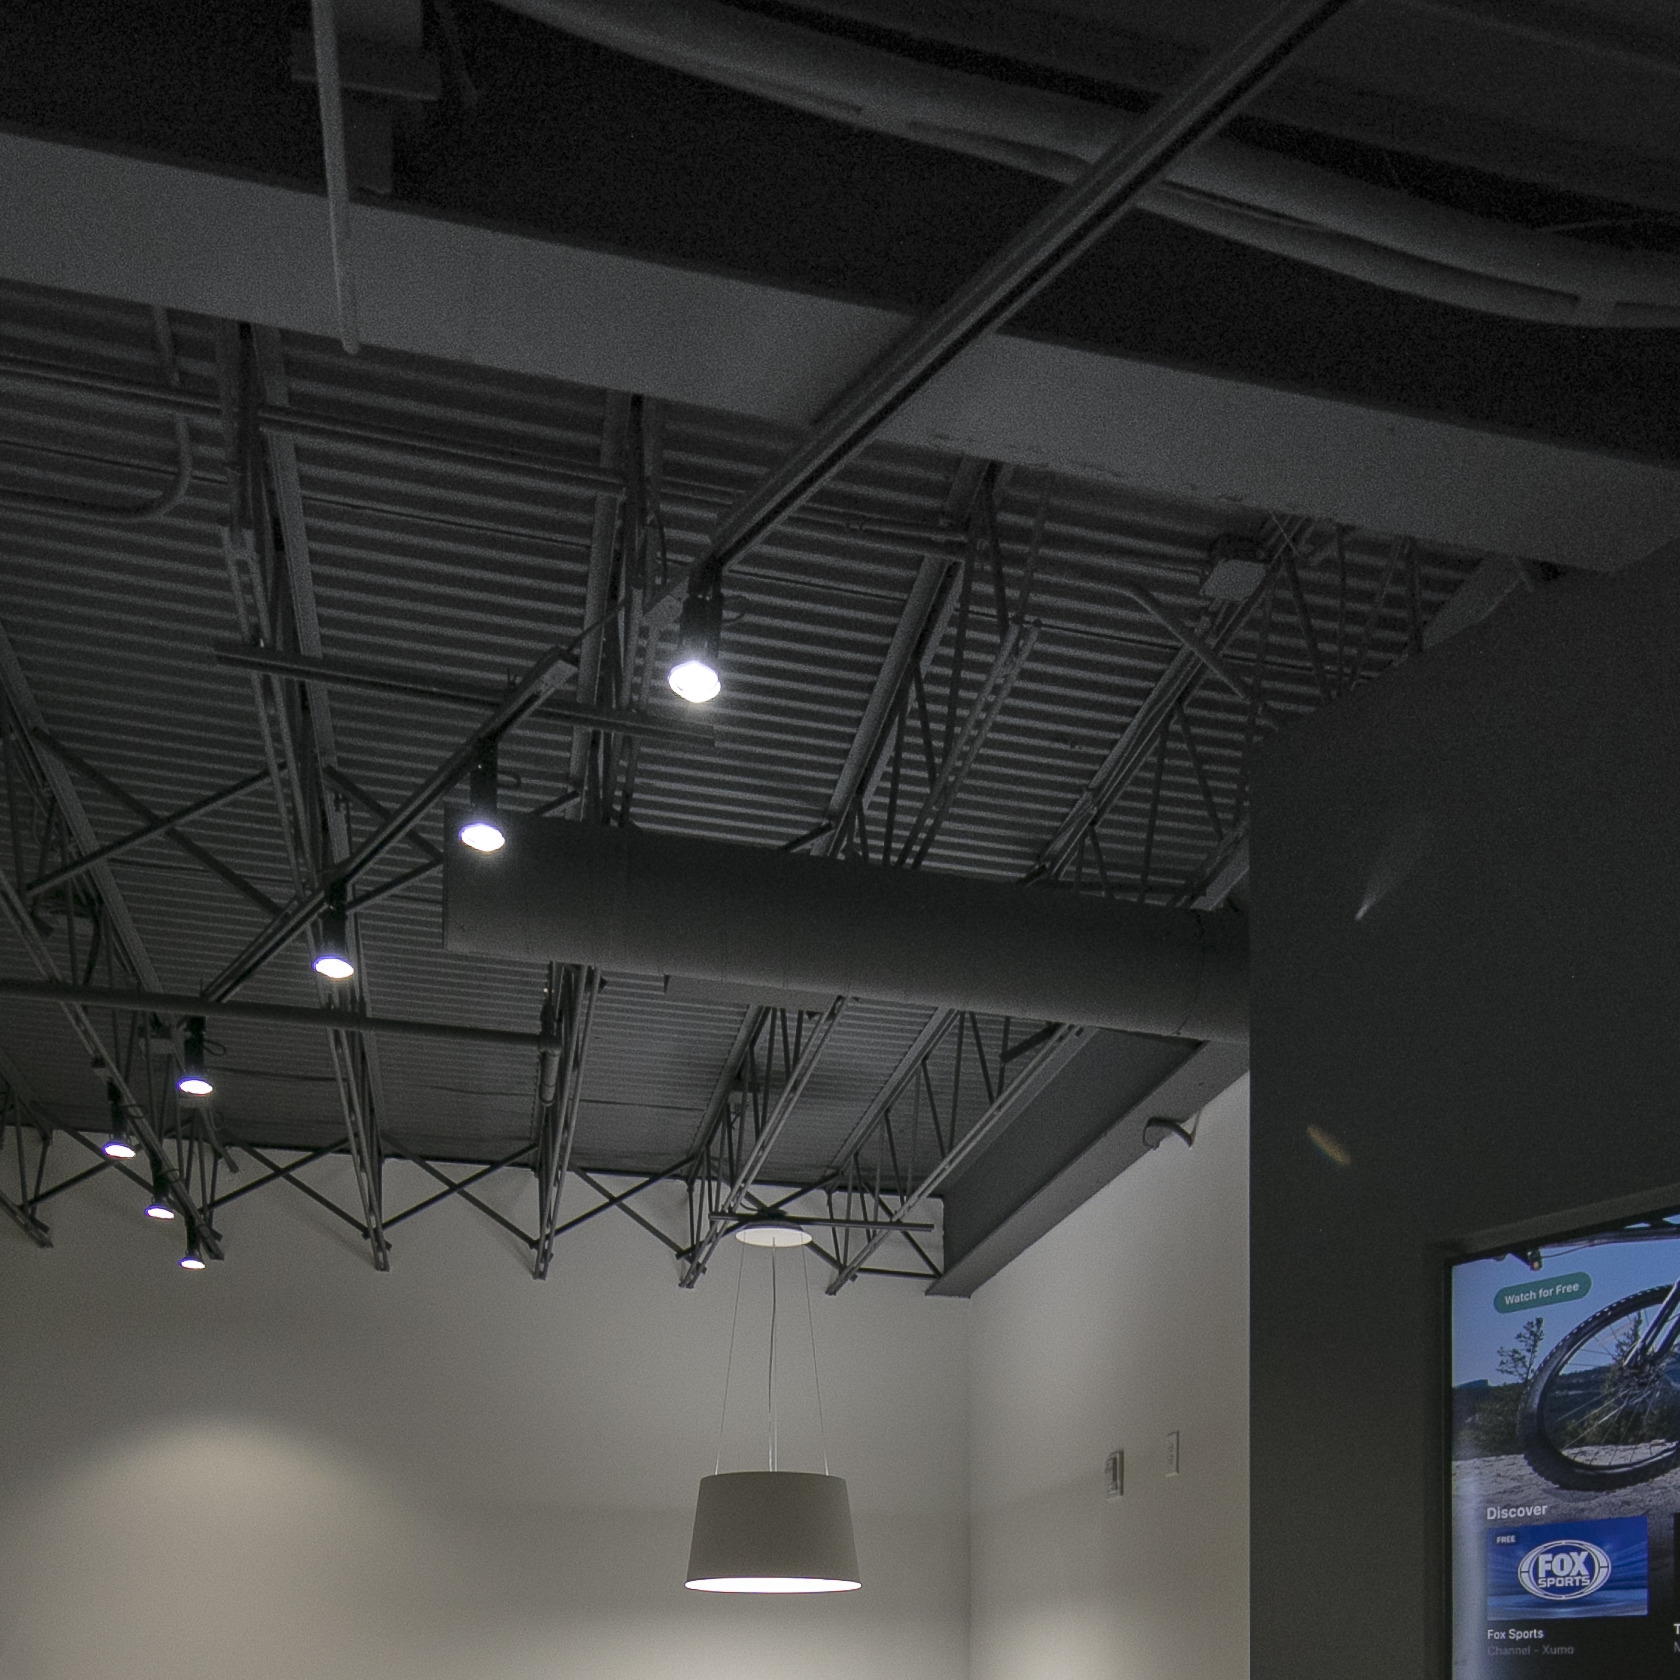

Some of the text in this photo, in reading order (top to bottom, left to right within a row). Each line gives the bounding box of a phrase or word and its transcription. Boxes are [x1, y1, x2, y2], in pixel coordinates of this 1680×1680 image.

[1504, 1282, 1580, 1306] Watch for Free
[1486, 1505, 1549, 1520] Discover
[1496, 1534, 1517, 1545] FREE
[1538, 1551, 1590, 1579] FOX
[1538, 1575, 1591, 1588] SPORTS
[1487, 1628, 1544, 1642] Fox Sports
[1487, 1645, 1531, 1657] Channel
[1541, 1644, 1575, 1656] Xumo
